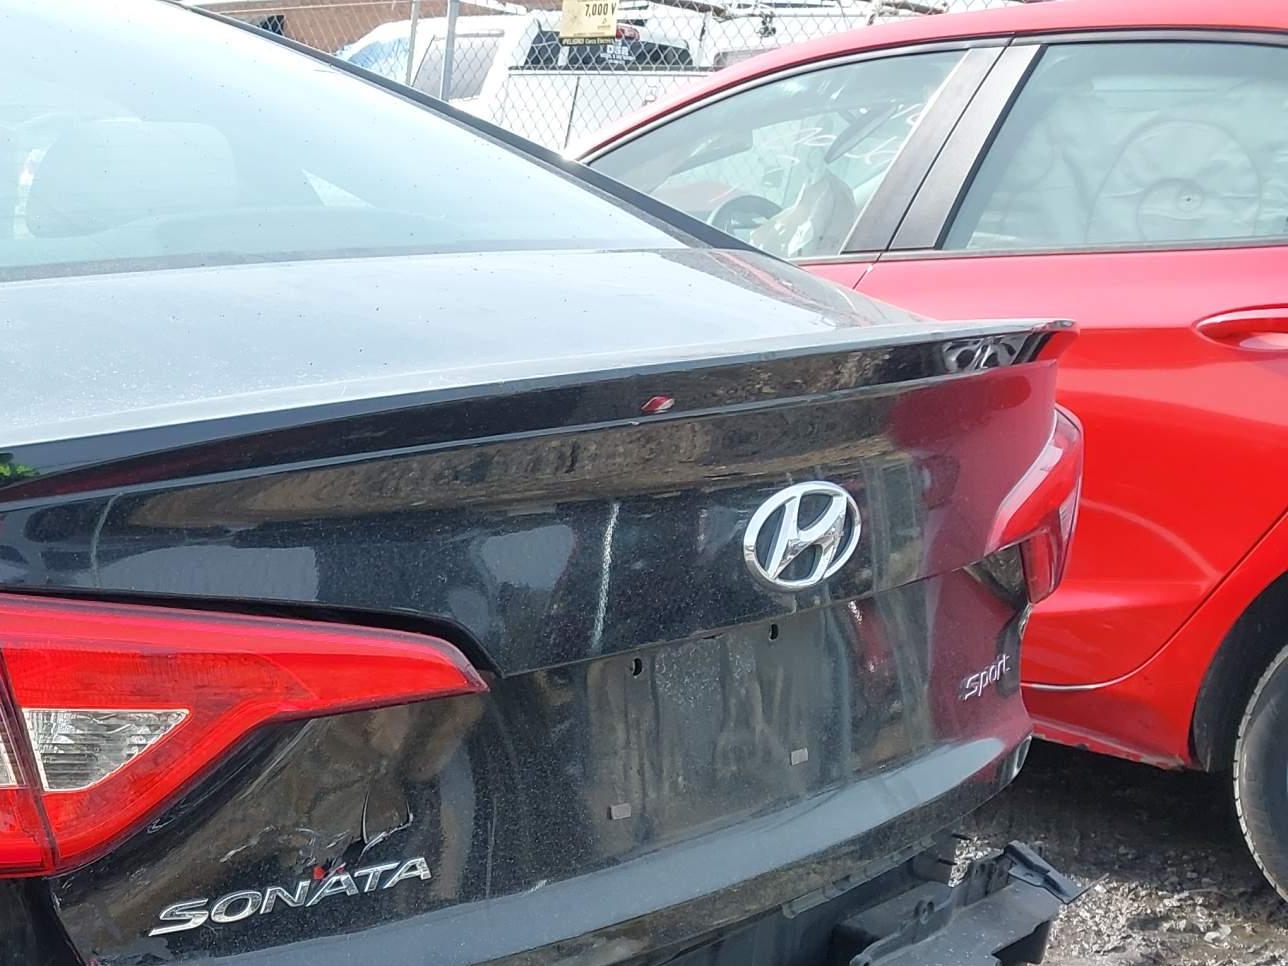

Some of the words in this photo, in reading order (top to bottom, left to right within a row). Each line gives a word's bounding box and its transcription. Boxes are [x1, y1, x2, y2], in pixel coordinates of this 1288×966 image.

[584, 3, 609, 17] 7,000
[960, 653, 1011, 700] Sport
[147, 856, 432, 938] SONATA
